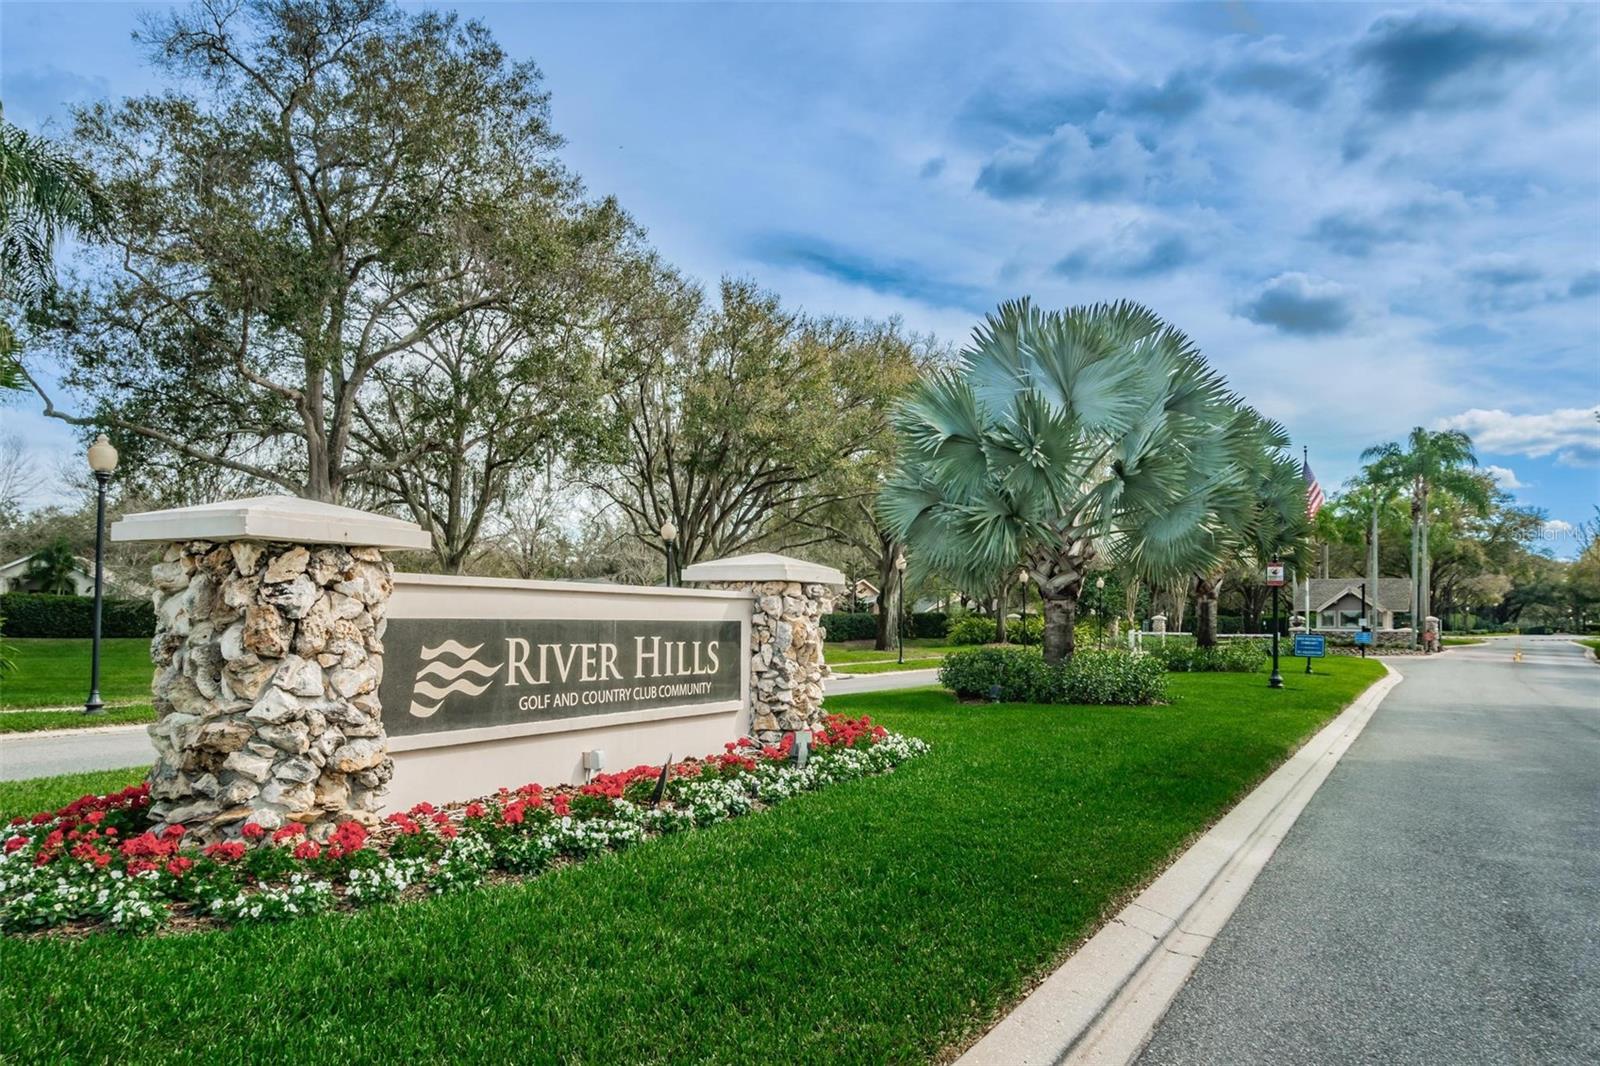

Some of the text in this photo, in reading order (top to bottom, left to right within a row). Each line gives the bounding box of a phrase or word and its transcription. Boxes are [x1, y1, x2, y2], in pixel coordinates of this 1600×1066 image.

[505, 636, 719, 686] RIVER HILLS
[519, 682, 712, 711] GOLF AND COUNTRY CLUB COMMUNITY
